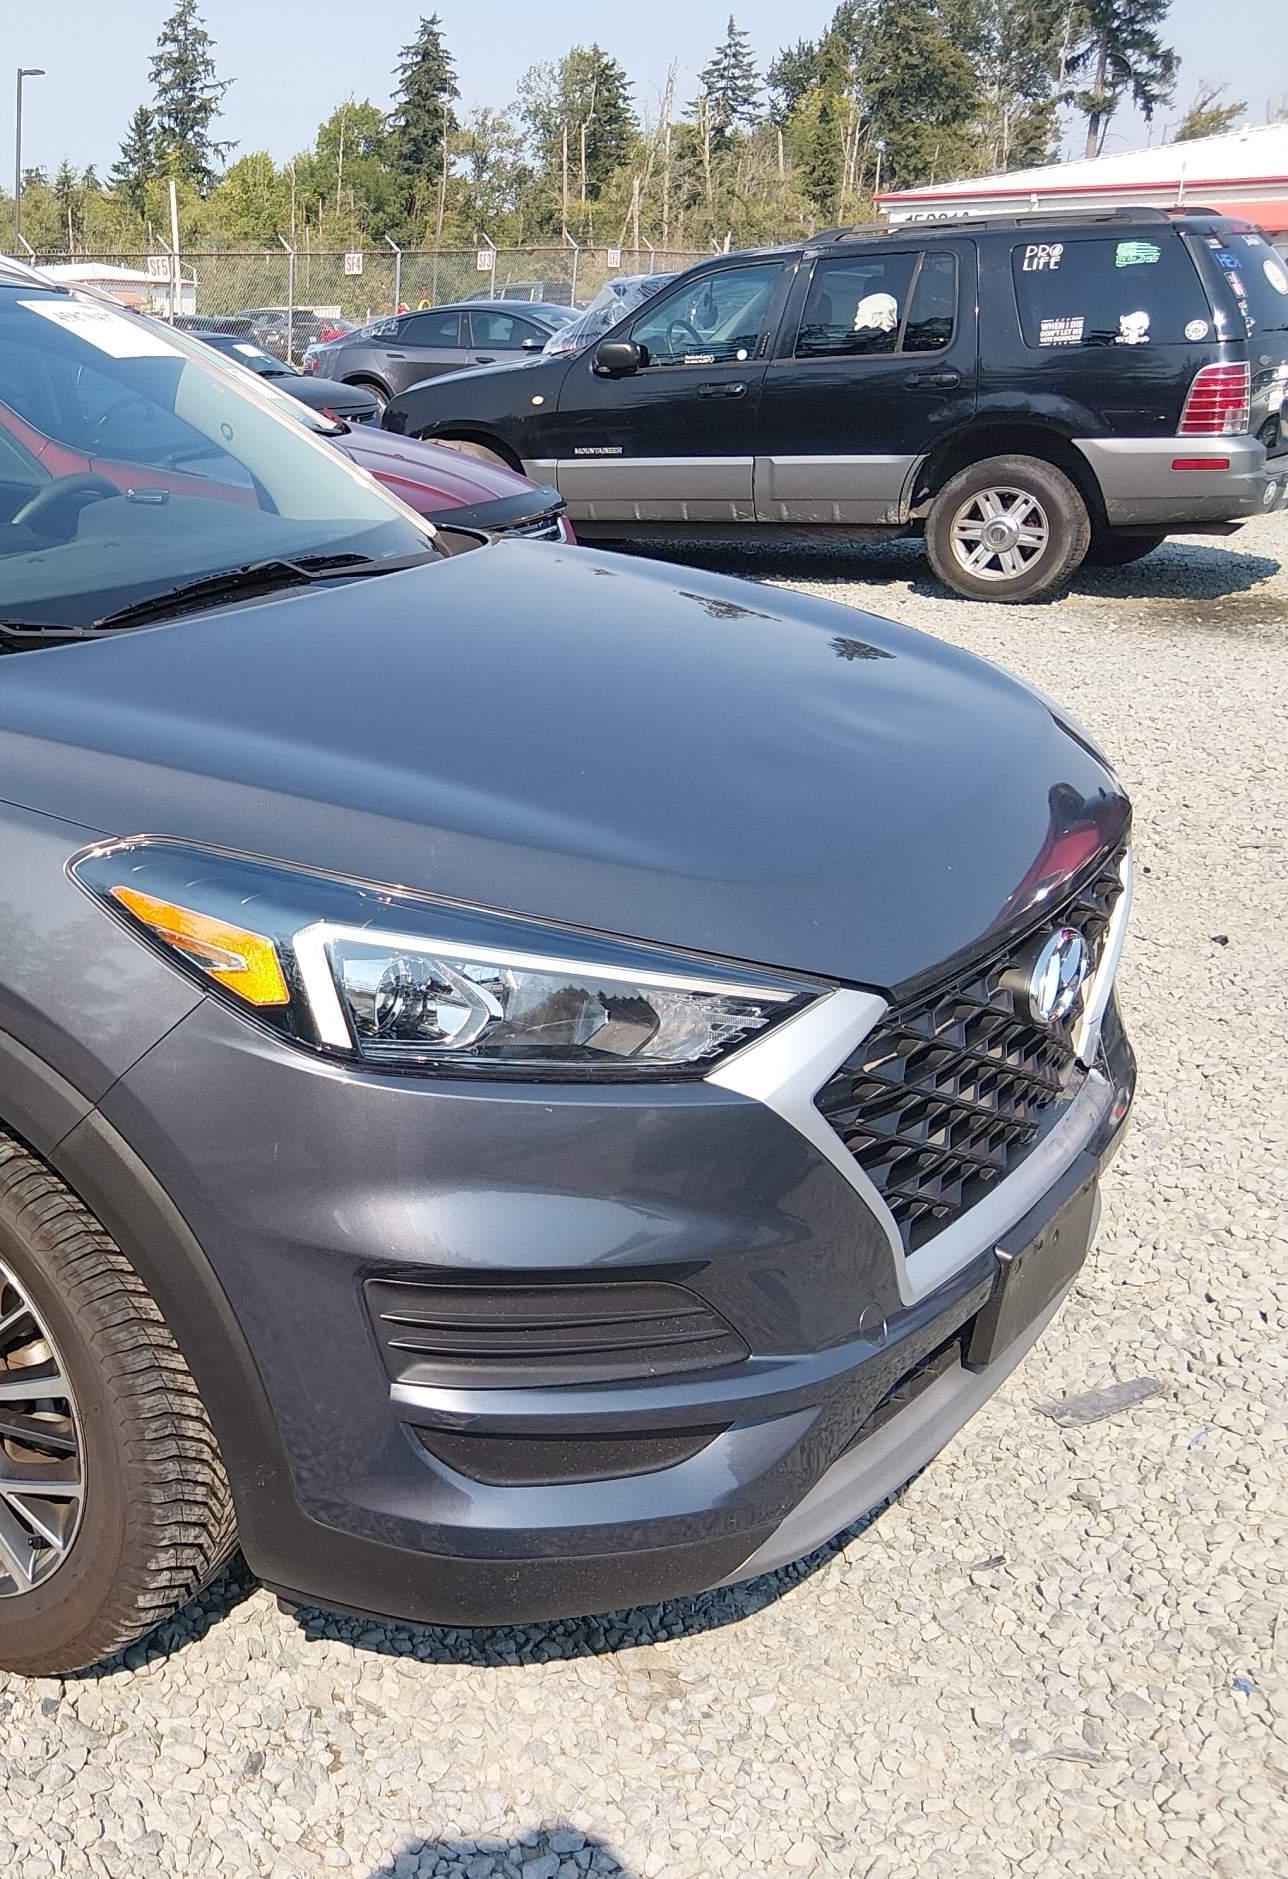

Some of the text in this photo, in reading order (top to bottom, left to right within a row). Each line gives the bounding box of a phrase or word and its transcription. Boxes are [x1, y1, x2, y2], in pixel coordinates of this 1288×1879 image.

[1025, 243, 1064, 258] PRO
[149, 258, 168, 276] SF5
[346, 256, 361, 272] SF4
[1022, 256, 1061, 271] LIFE
[1041, 321, 1065, 331] WHEN
[574, 446, 623, 455] MOUNTAINEER
